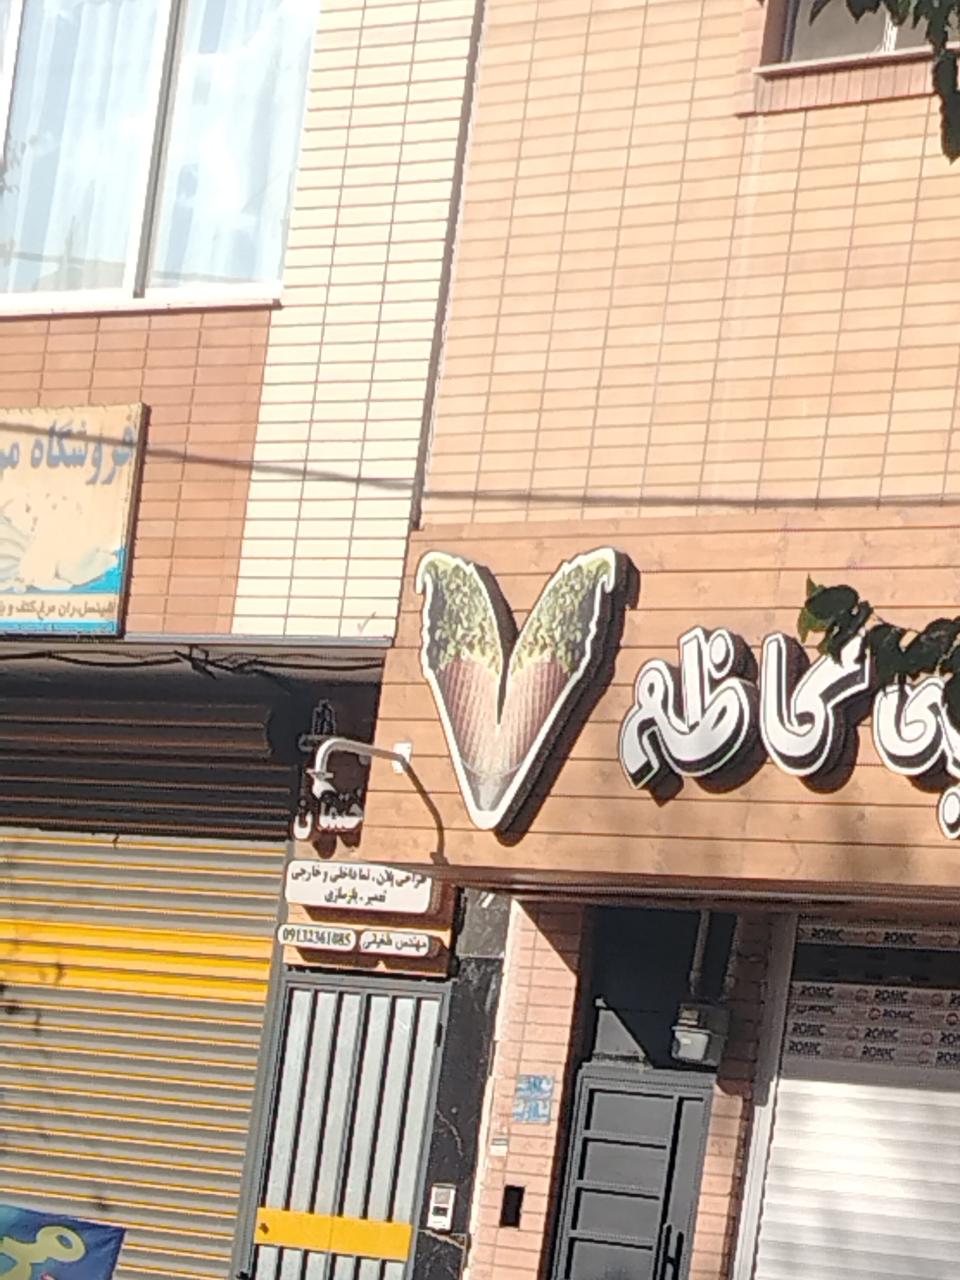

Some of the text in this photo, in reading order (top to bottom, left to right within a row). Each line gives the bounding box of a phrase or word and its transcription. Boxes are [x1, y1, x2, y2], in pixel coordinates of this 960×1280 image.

[30, 414, 134, 485] فروشگاه
[618, 625, 873, 790] کاظم
[291, 863, 322, 882] خارجی
[330, 866, 357, 883] داخلی
